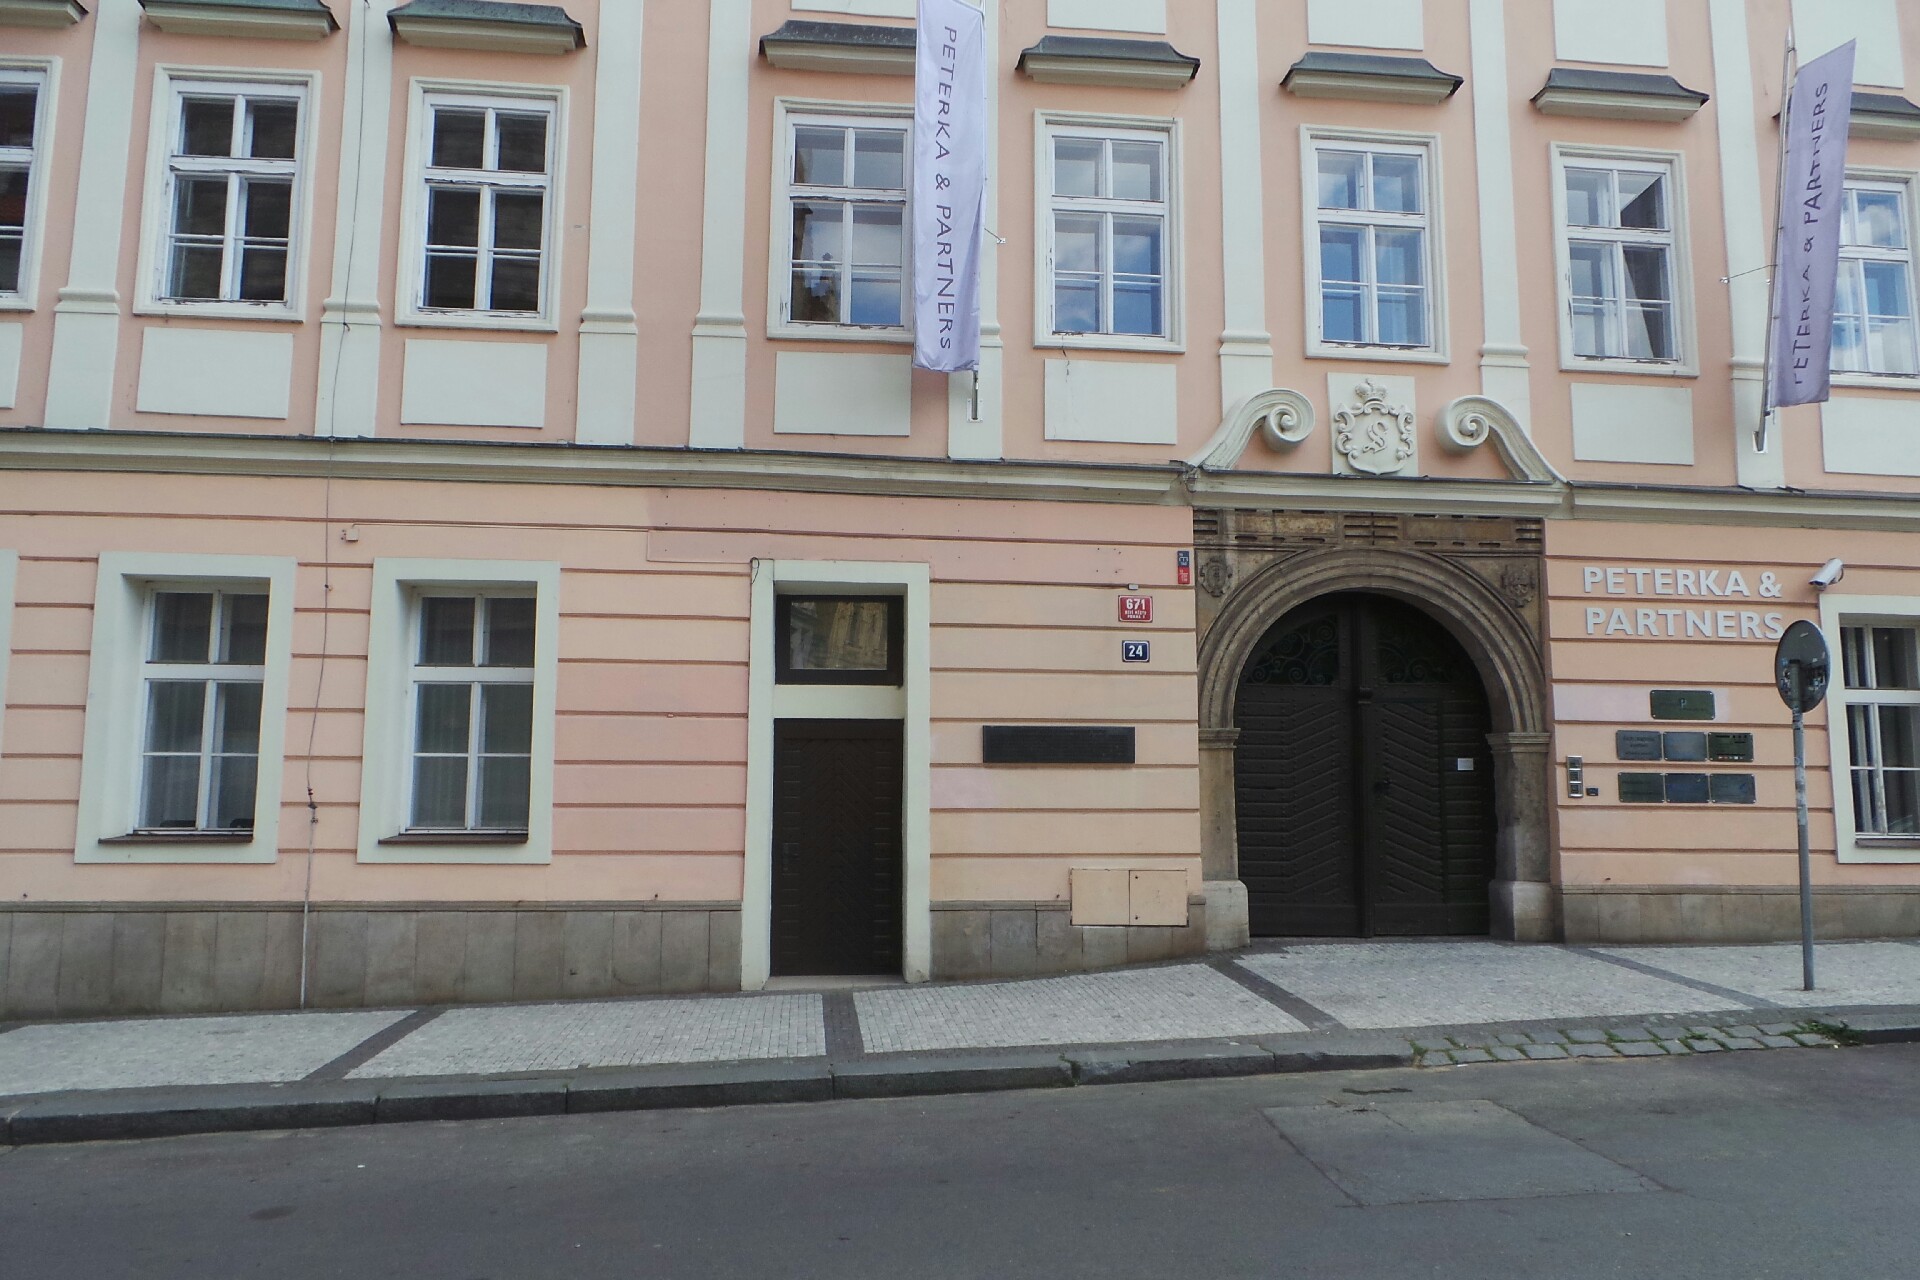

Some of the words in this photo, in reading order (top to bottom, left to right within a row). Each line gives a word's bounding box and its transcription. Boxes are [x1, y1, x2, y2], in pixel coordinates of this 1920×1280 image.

[935, 26, 957, 160] PETERKA
[1803, 83, 1828, 225] PARTNERS
[935, 173, 951, 191] &
[936, 204, 956, 350] PARTNERS
[1583, 566, 1750, 597] PETERKA
[1758, 571, 1782, 598] &
[1126, 598, 1145, 610] 671
[1585, 607, 1784, 640] PARTNERS
[1128, 645, 1143, 657] 24
